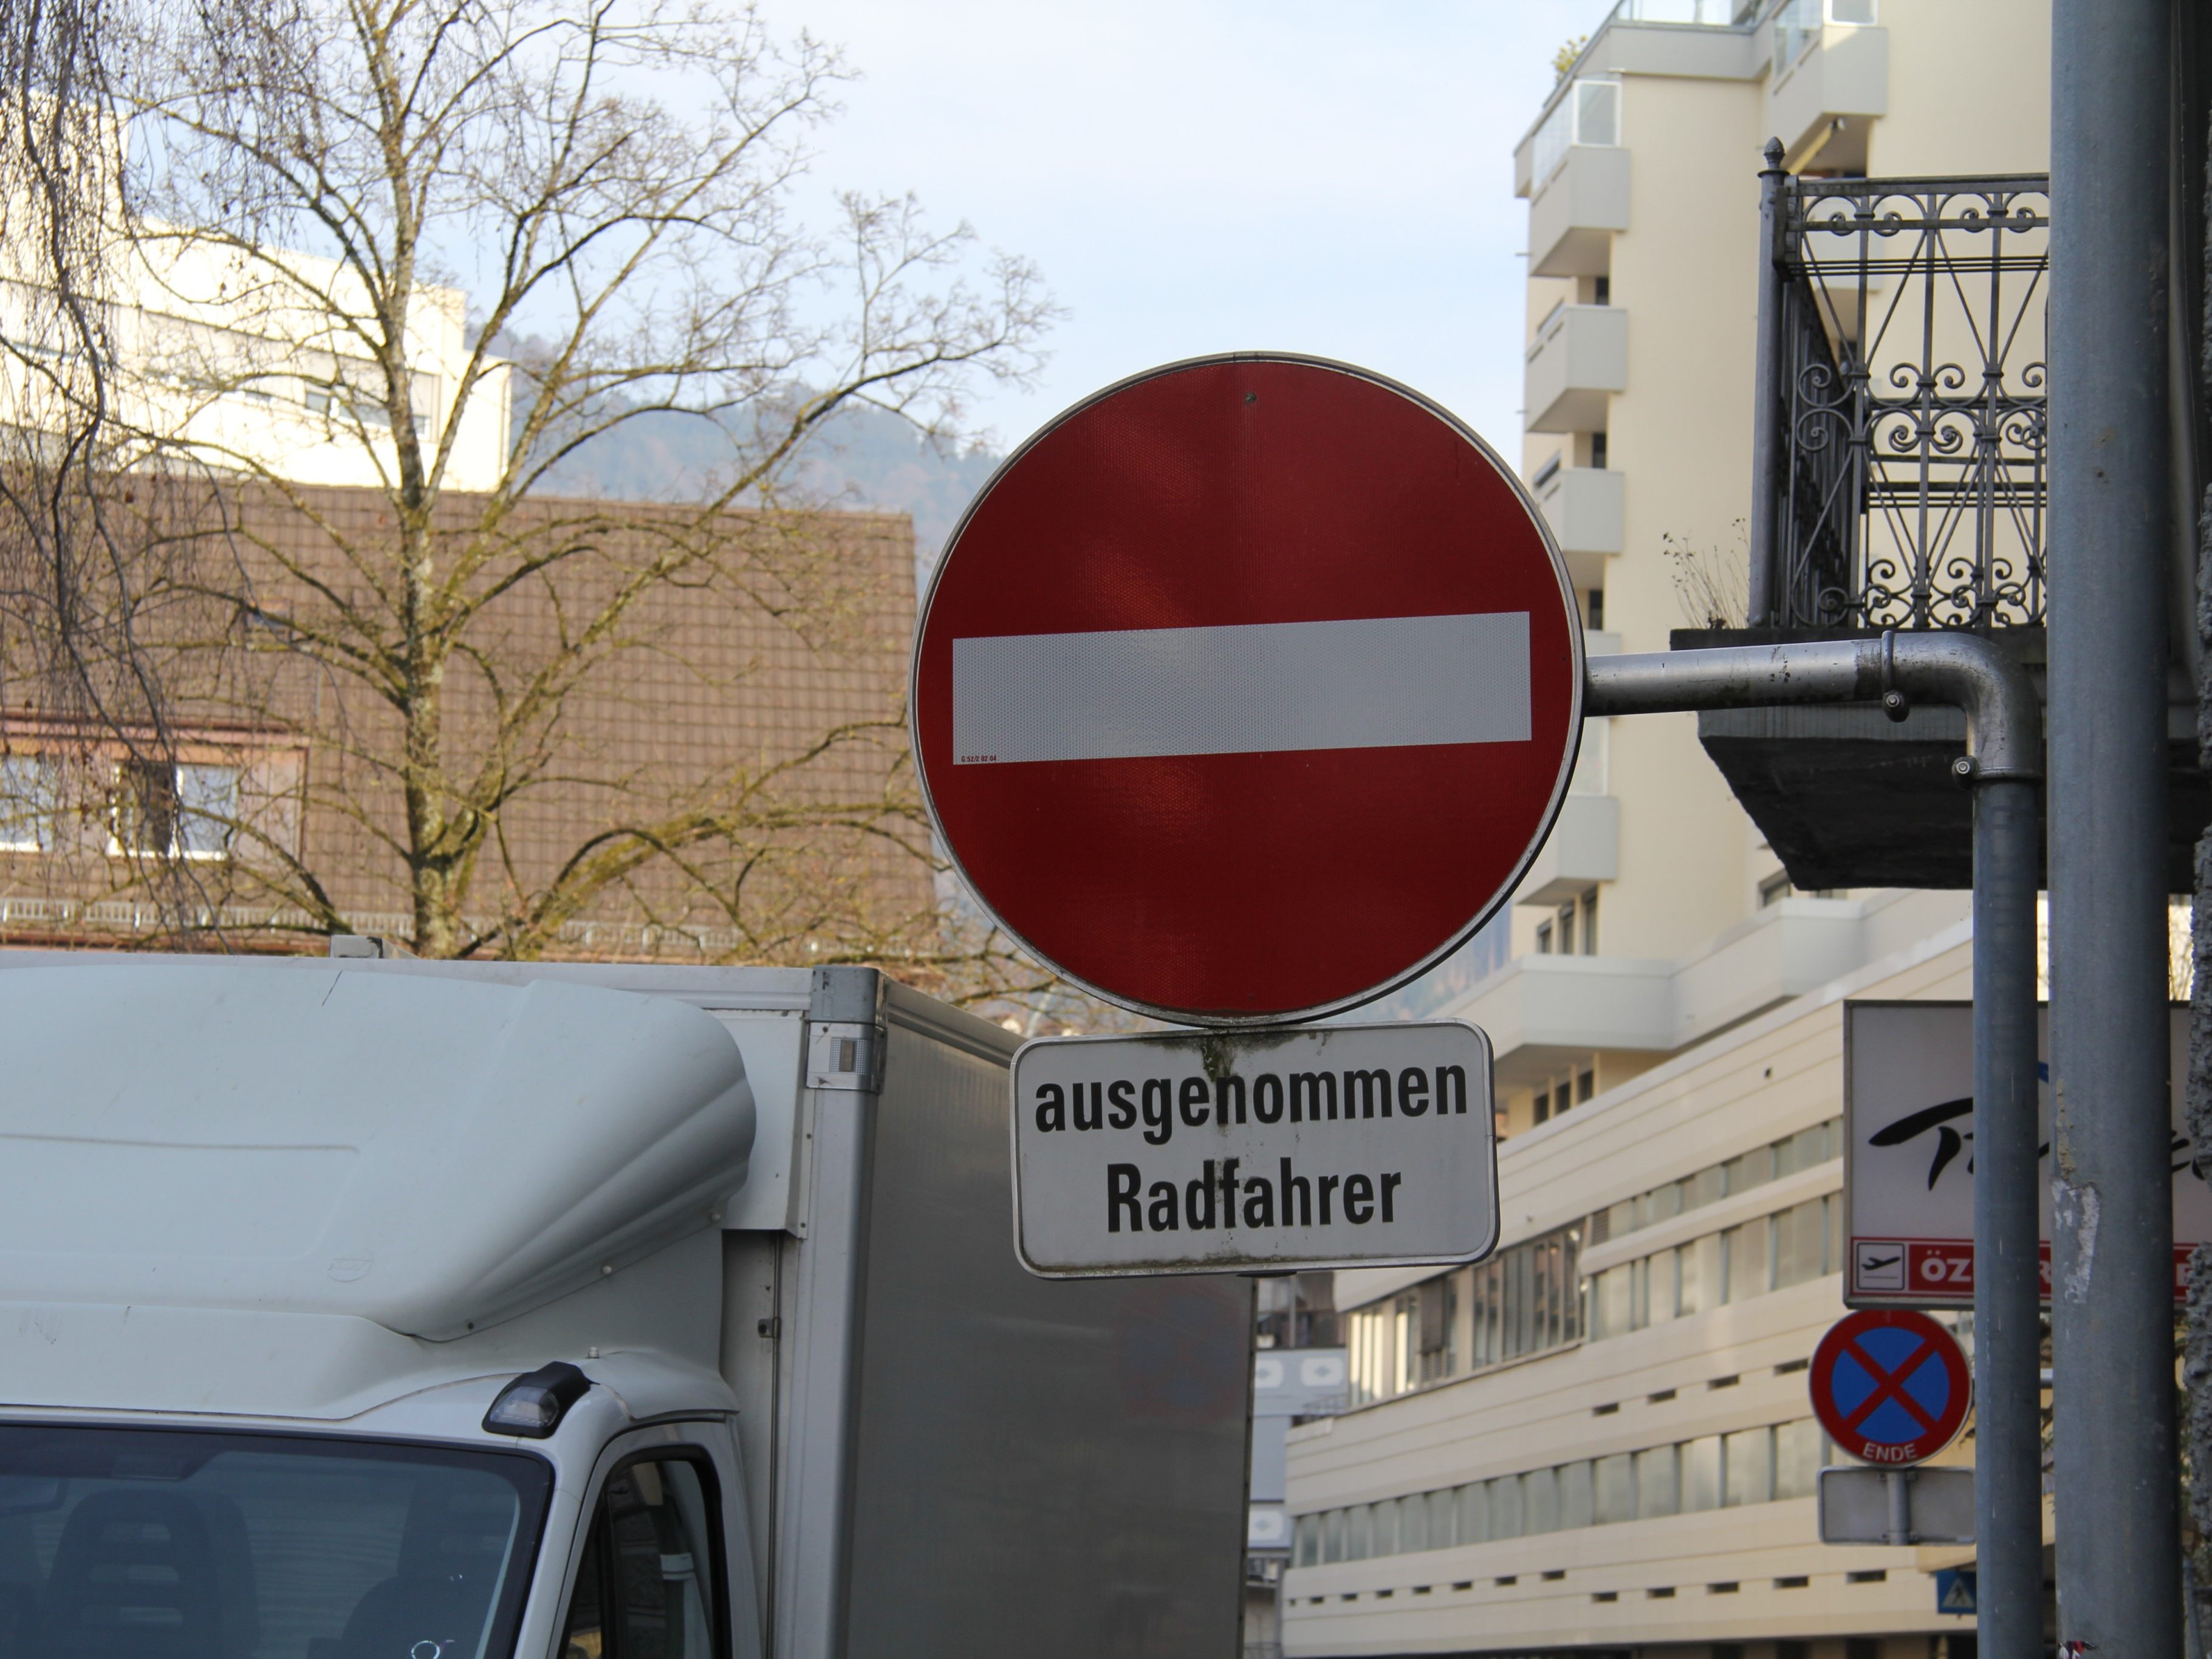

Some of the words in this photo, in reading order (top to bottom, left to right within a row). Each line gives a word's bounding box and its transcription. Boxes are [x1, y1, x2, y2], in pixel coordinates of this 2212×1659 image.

[1035, 1064, 1467, 1145] ausgenommen
[1108, 1157, 1402, 1233] Radfahrer
[1863, 1442, 1917, 1461] ENDE
